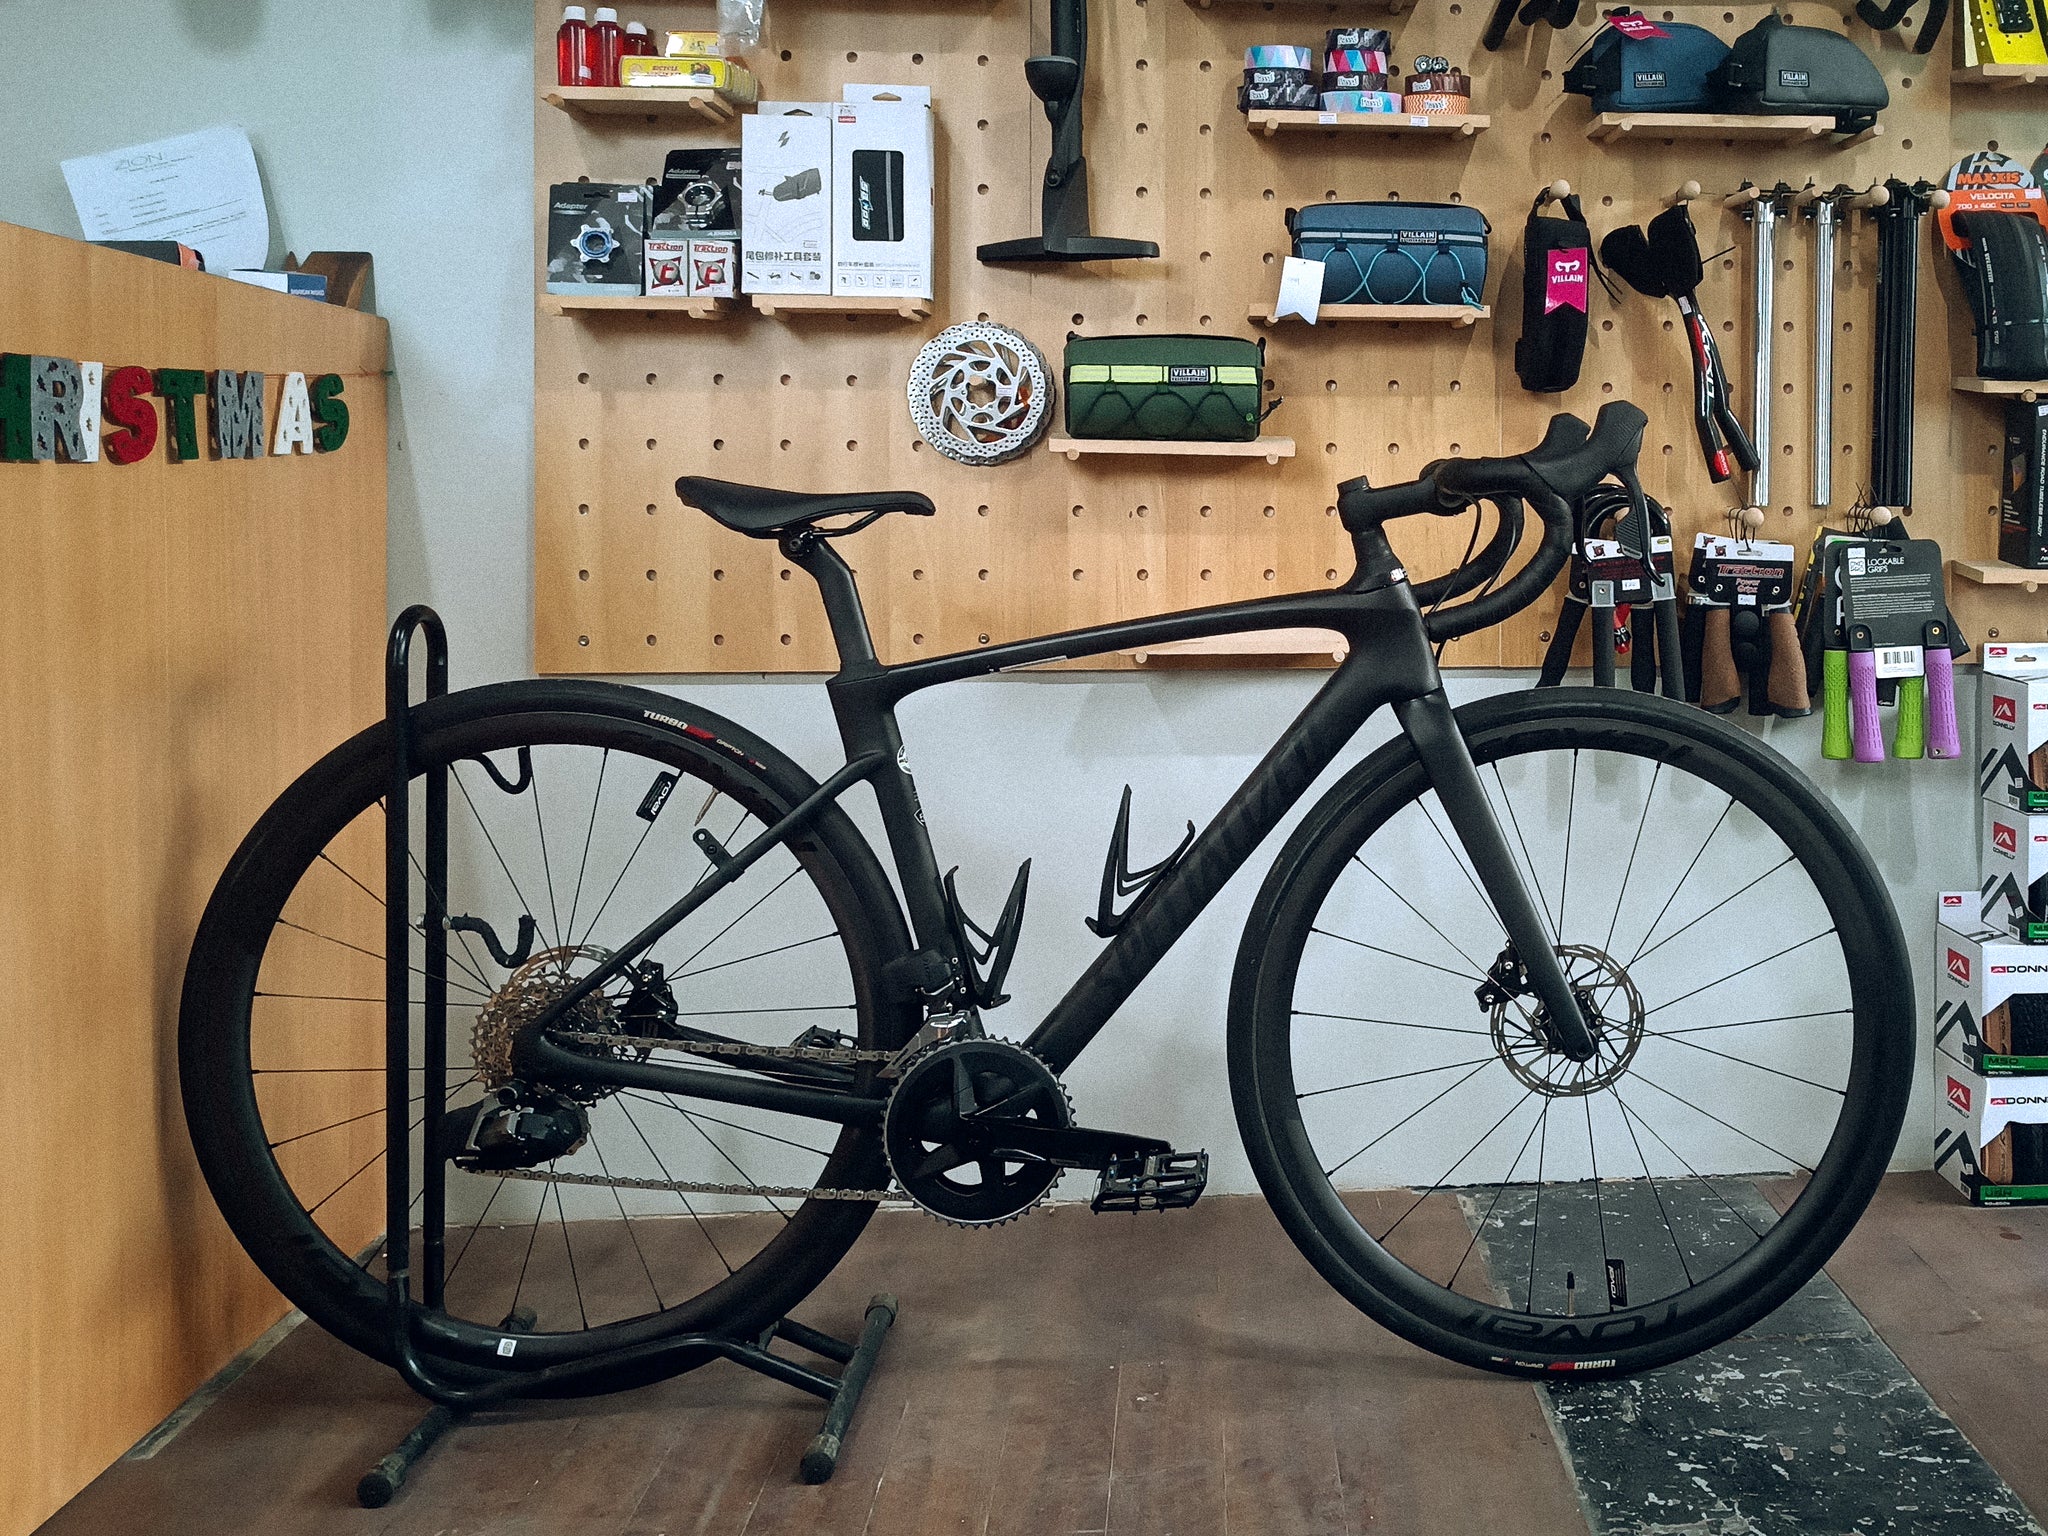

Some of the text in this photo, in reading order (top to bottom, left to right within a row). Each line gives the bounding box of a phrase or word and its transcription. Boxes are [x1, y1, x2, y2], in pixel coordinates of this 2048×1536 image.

[1957, 172, 2021, 185] MAXXIS
[1970, 192, 2015, 200] VELOCITA
[553, 202, 588, 210] Adapter
[1551, 274, 1584, 283] VILLAIN
[1173, 369, 1206, 377] VILLAIN
[1867, 557, 1904, 567] LOCKABLE
[1867, 566, 1888, 574] GRIPS
[643, 710, 688, 730] TURBO
[1574, 1359, 1616, 1370] TURBO
